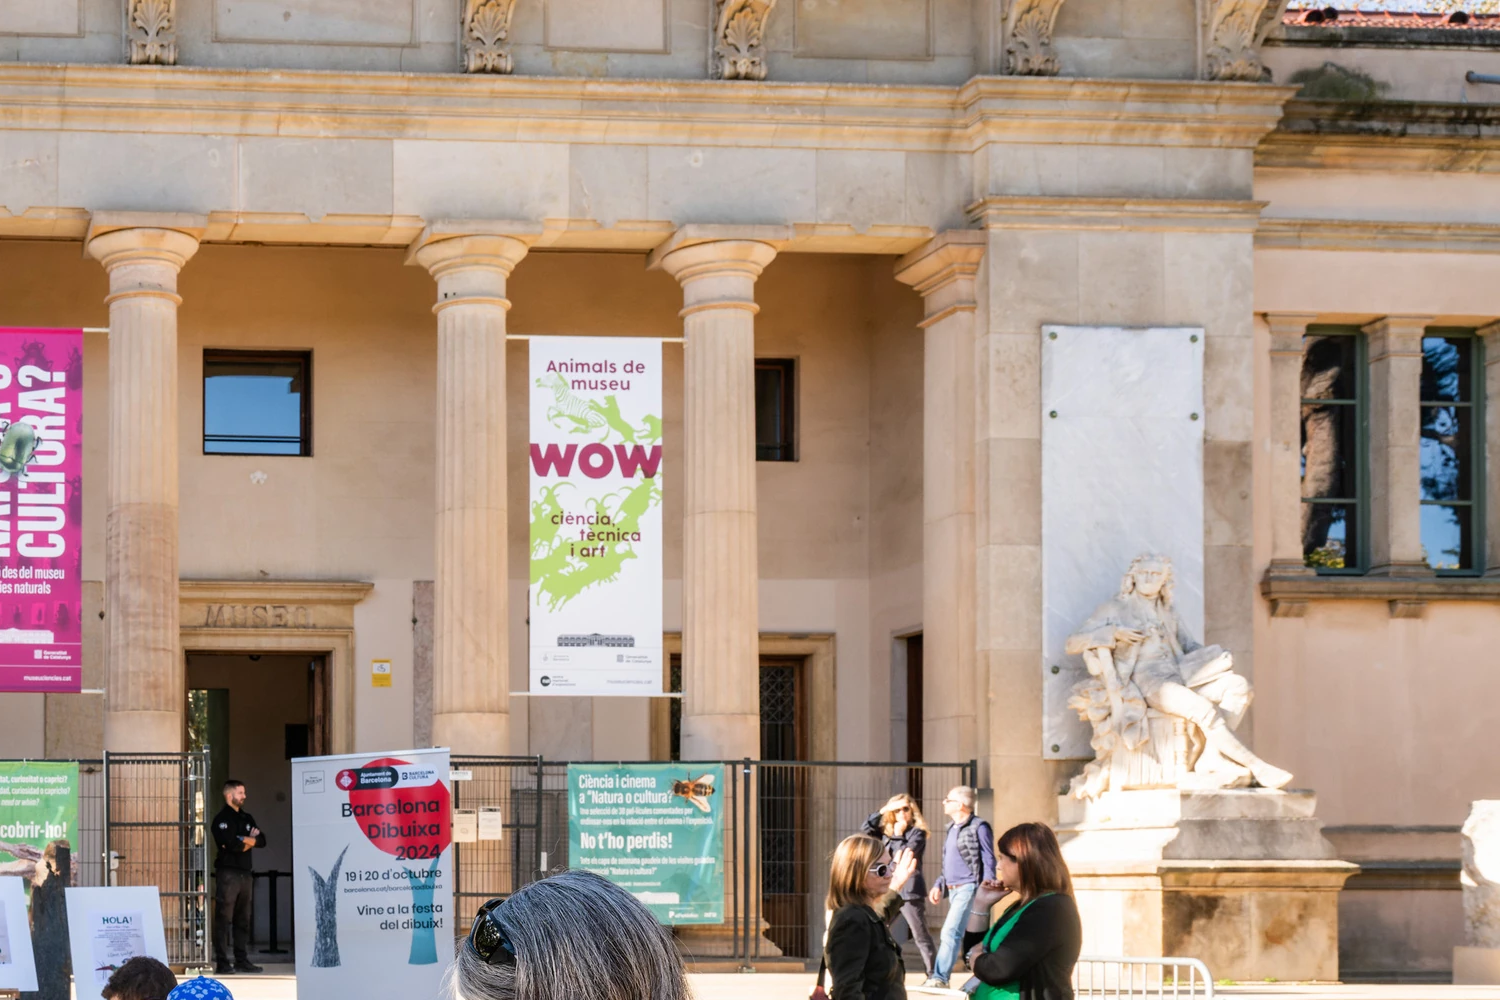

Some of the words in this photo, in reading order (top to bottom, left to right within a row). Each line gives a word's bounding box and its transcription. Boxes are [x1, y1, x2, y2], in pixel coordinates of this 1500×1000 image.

[546, 358, 617, 375] Animals
[623, 359, 645, 374] de
[570, 377, 631, 391] museu
[17, 365, 66, 558] CULTURA?
[529, 442, 663, 479] WOW
[551, 511, 616, 527] ciència,
[580, 526, 641, 542] tècnica
[570, 543, 575, 558] i
[580, 544, 606, 558] art
[2, 566, 18, 579] des
[19, 566, 33, 579] del
[34, 568, 65, 579] museu
[14, 581, 51, 594] naturals
[578, 774, 614, 789] Ciència
[616, 774, 619, 788] i
[621, 774, 656, 788] cinema
[579, 793, 585, 804] a
[626, 793, 632, 804] o
[341, 799, 440, 818] Barcelona
[367, 821, 440, 839] Dibuixa
[581, 832, 596, 849] No
[598, 832, 624, 849] t'ho
[626, 832, 672, 853] perdis!
[395, 844, 441, 861] 2024
[345, 871, 357, 882] 19
[359, 870, 362, 881] i
[364, 870, 379, 881] 20
[382, 868, 442, 880] d'octubre
[357, 904, 384, 916] Vine
[386, 906, 395, 914] a
[398, 904, 410, 914] la
[412, 902, 443, 914] festa
[102, 916, 132, 925] HOLA!
[380, 920, 399, 930] del
[401, 918, 443, 930] dibuix!
